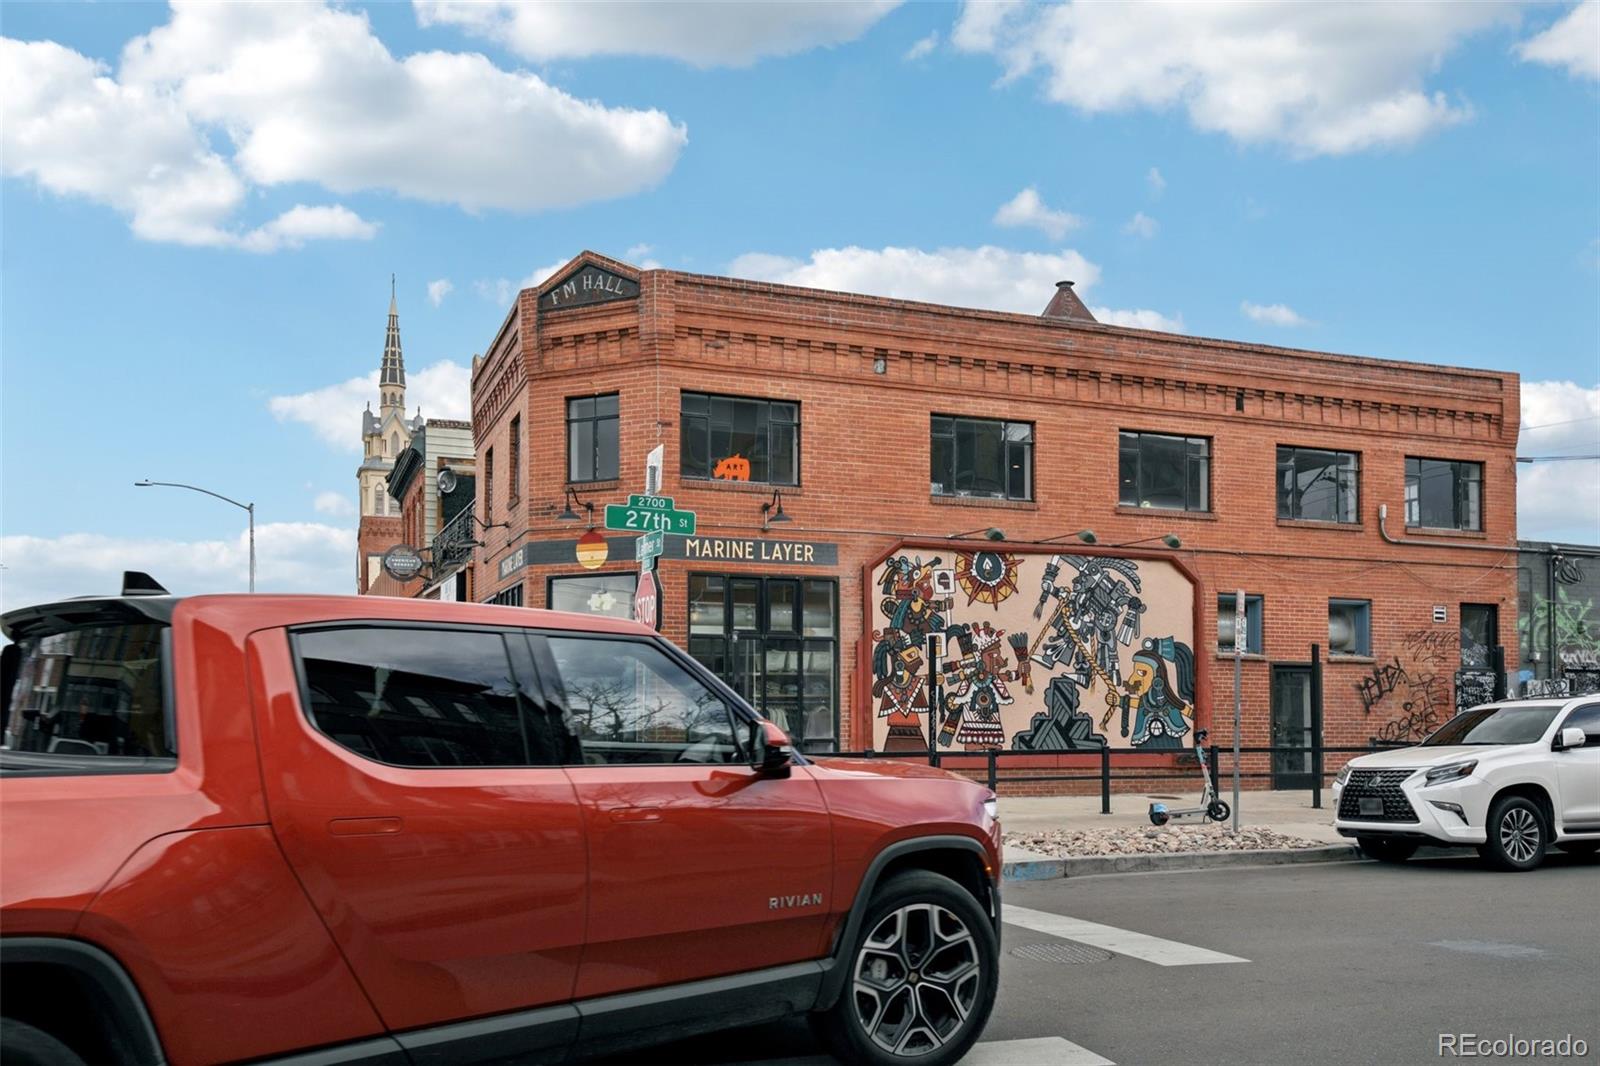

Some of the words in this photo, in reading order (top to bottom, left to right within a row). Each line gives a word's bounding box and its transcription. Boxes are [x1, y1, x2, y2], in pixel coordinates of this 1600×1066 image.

[582, 274, 625, 296] HALL
[726, 463, 744, 471] ART
[638, 497, 666, 508] 2700
[625, 510, 672, 531] 27th
[679, 518, 688, 528] St
[685, 538, 754, 560] MARINE
[761, 542, 814, 562] LAYER
[635, 594, 656, 624] STOP
[768, 892, 823, 910] RIVIAN
